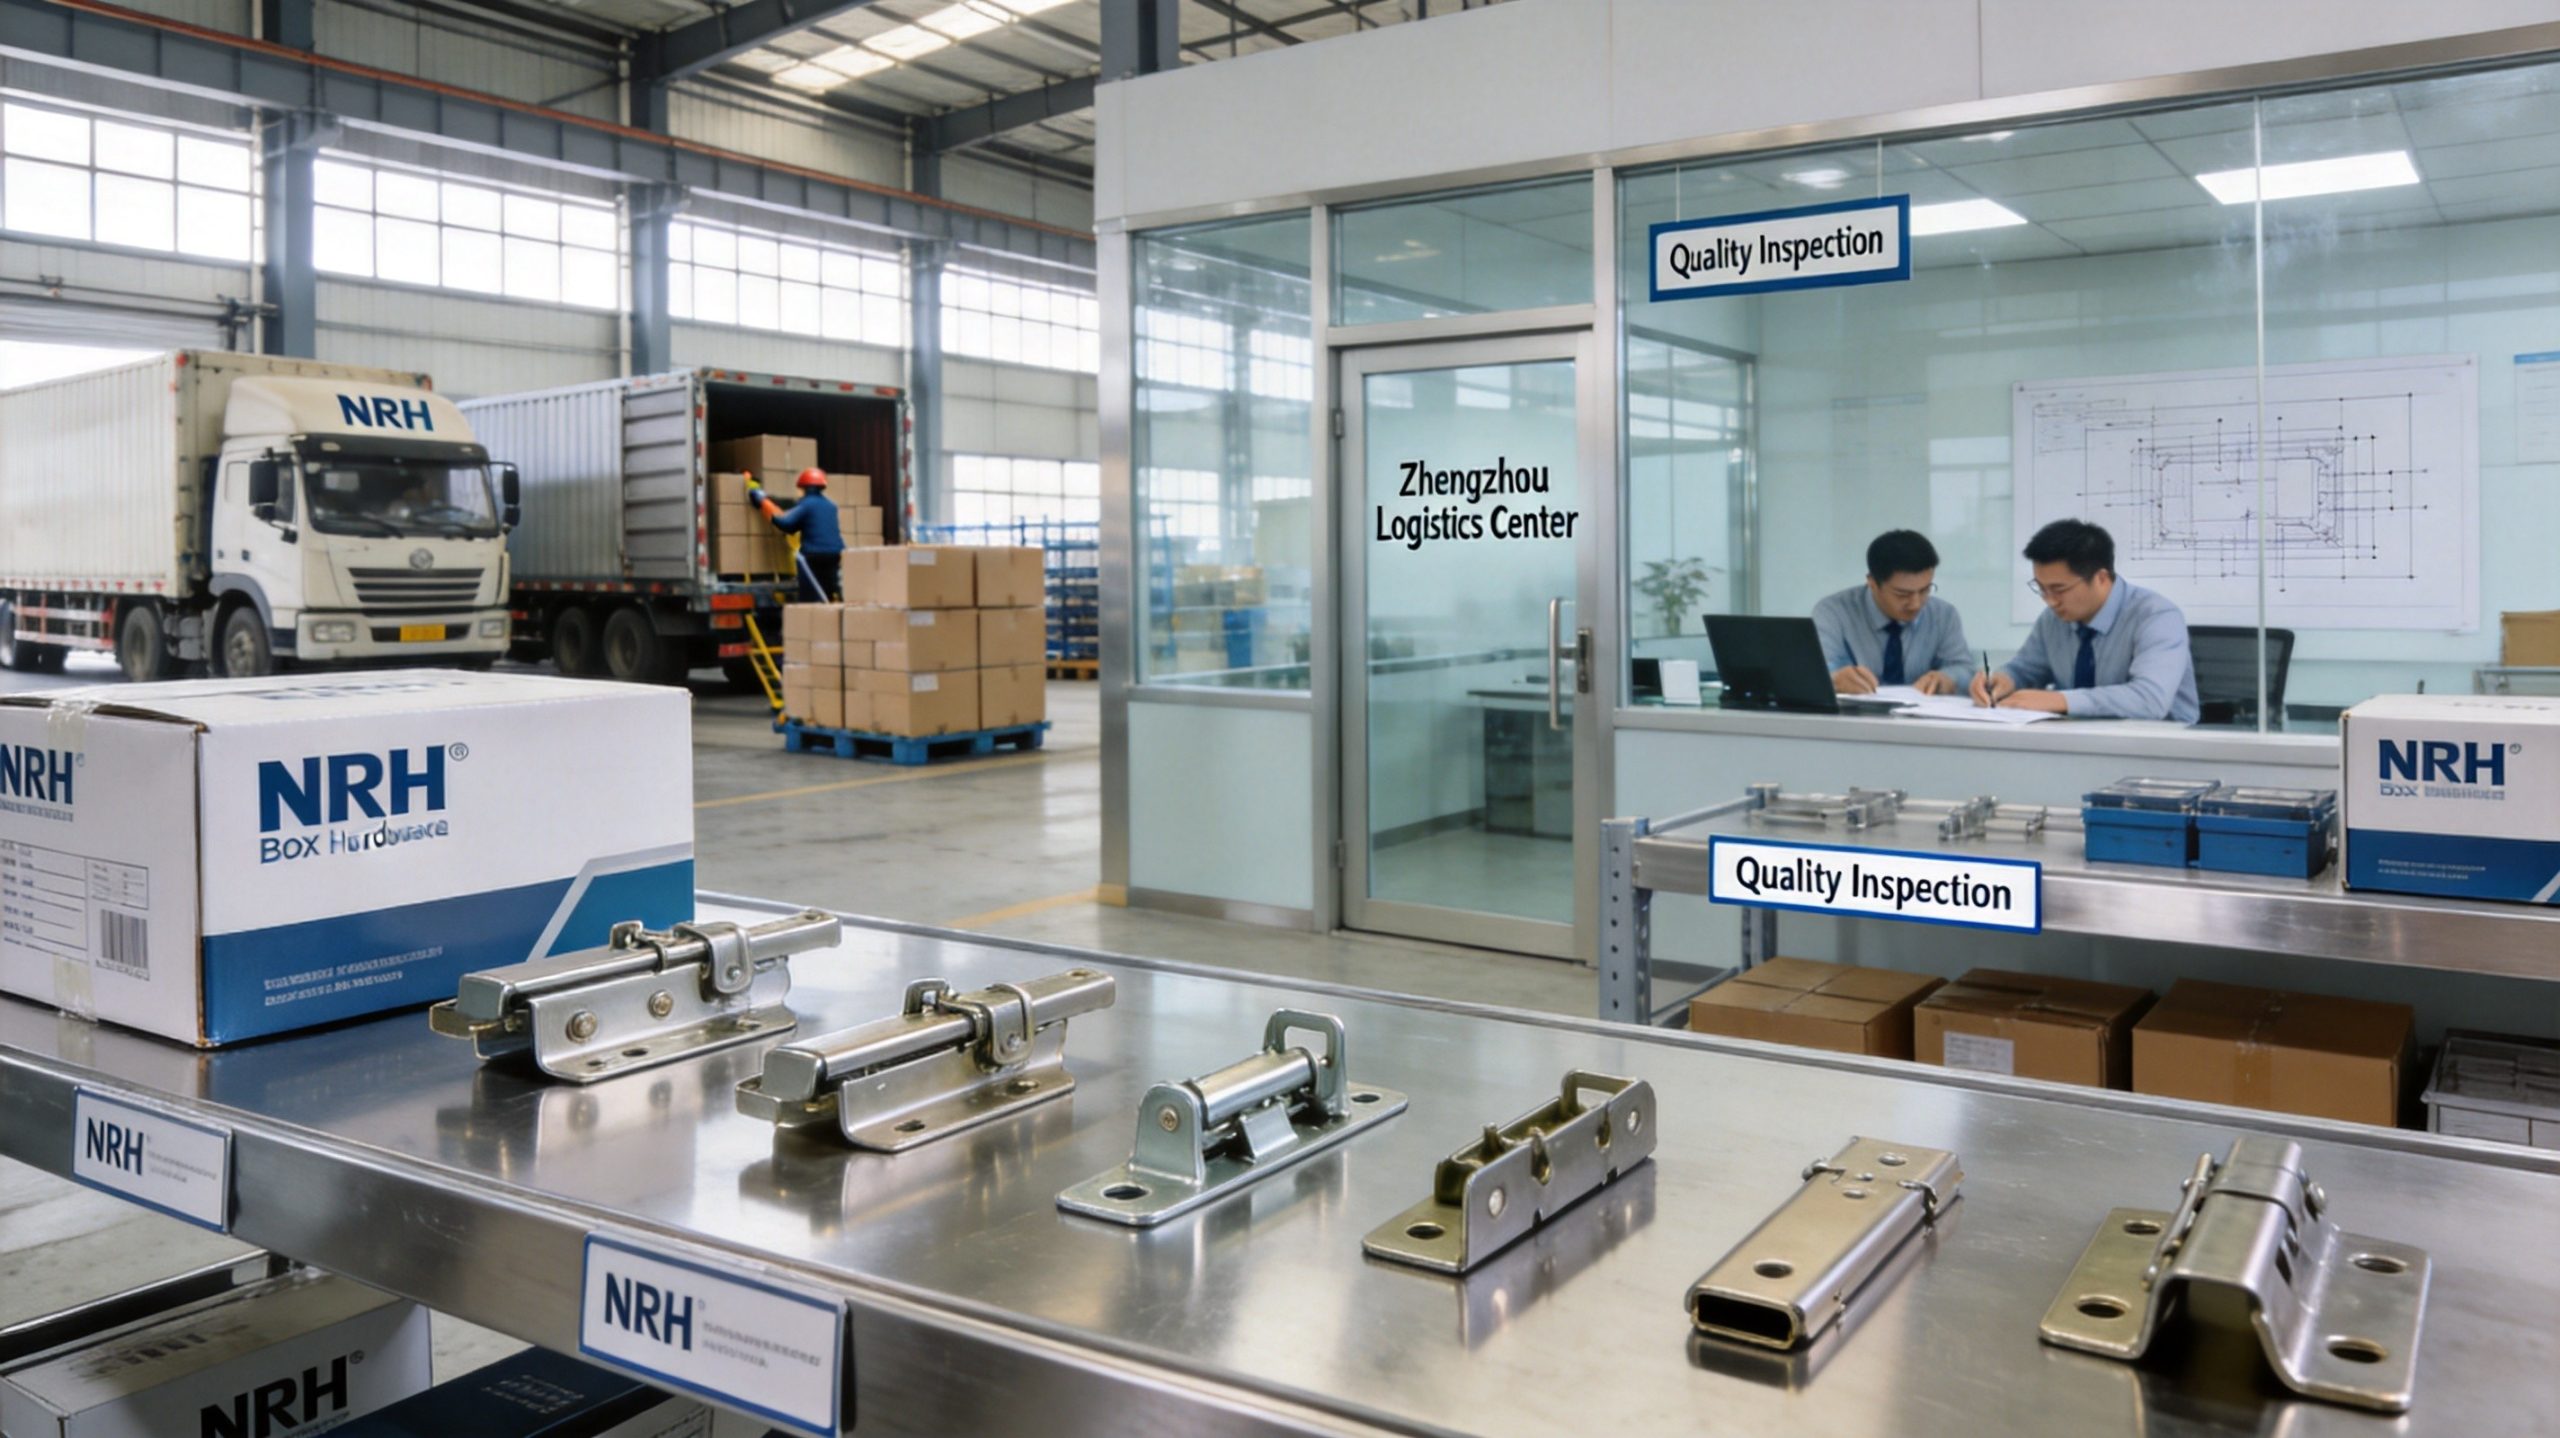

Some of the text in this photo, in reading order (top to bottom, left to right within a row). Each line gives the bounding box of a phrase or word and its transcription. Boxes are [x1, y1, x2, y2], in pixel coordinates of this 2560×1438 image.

[1669, 225, 1884, 280] Quality Inspection
[337, 394, 434, 432] NRH
[1399, 457, 1549, 504] Zhengzhou
[1376, 504, 1579, 551] Logistics Center
[1736, 855, 2012, 911] Quality Inspection
[86, 1117, 145, 1176] NRH
